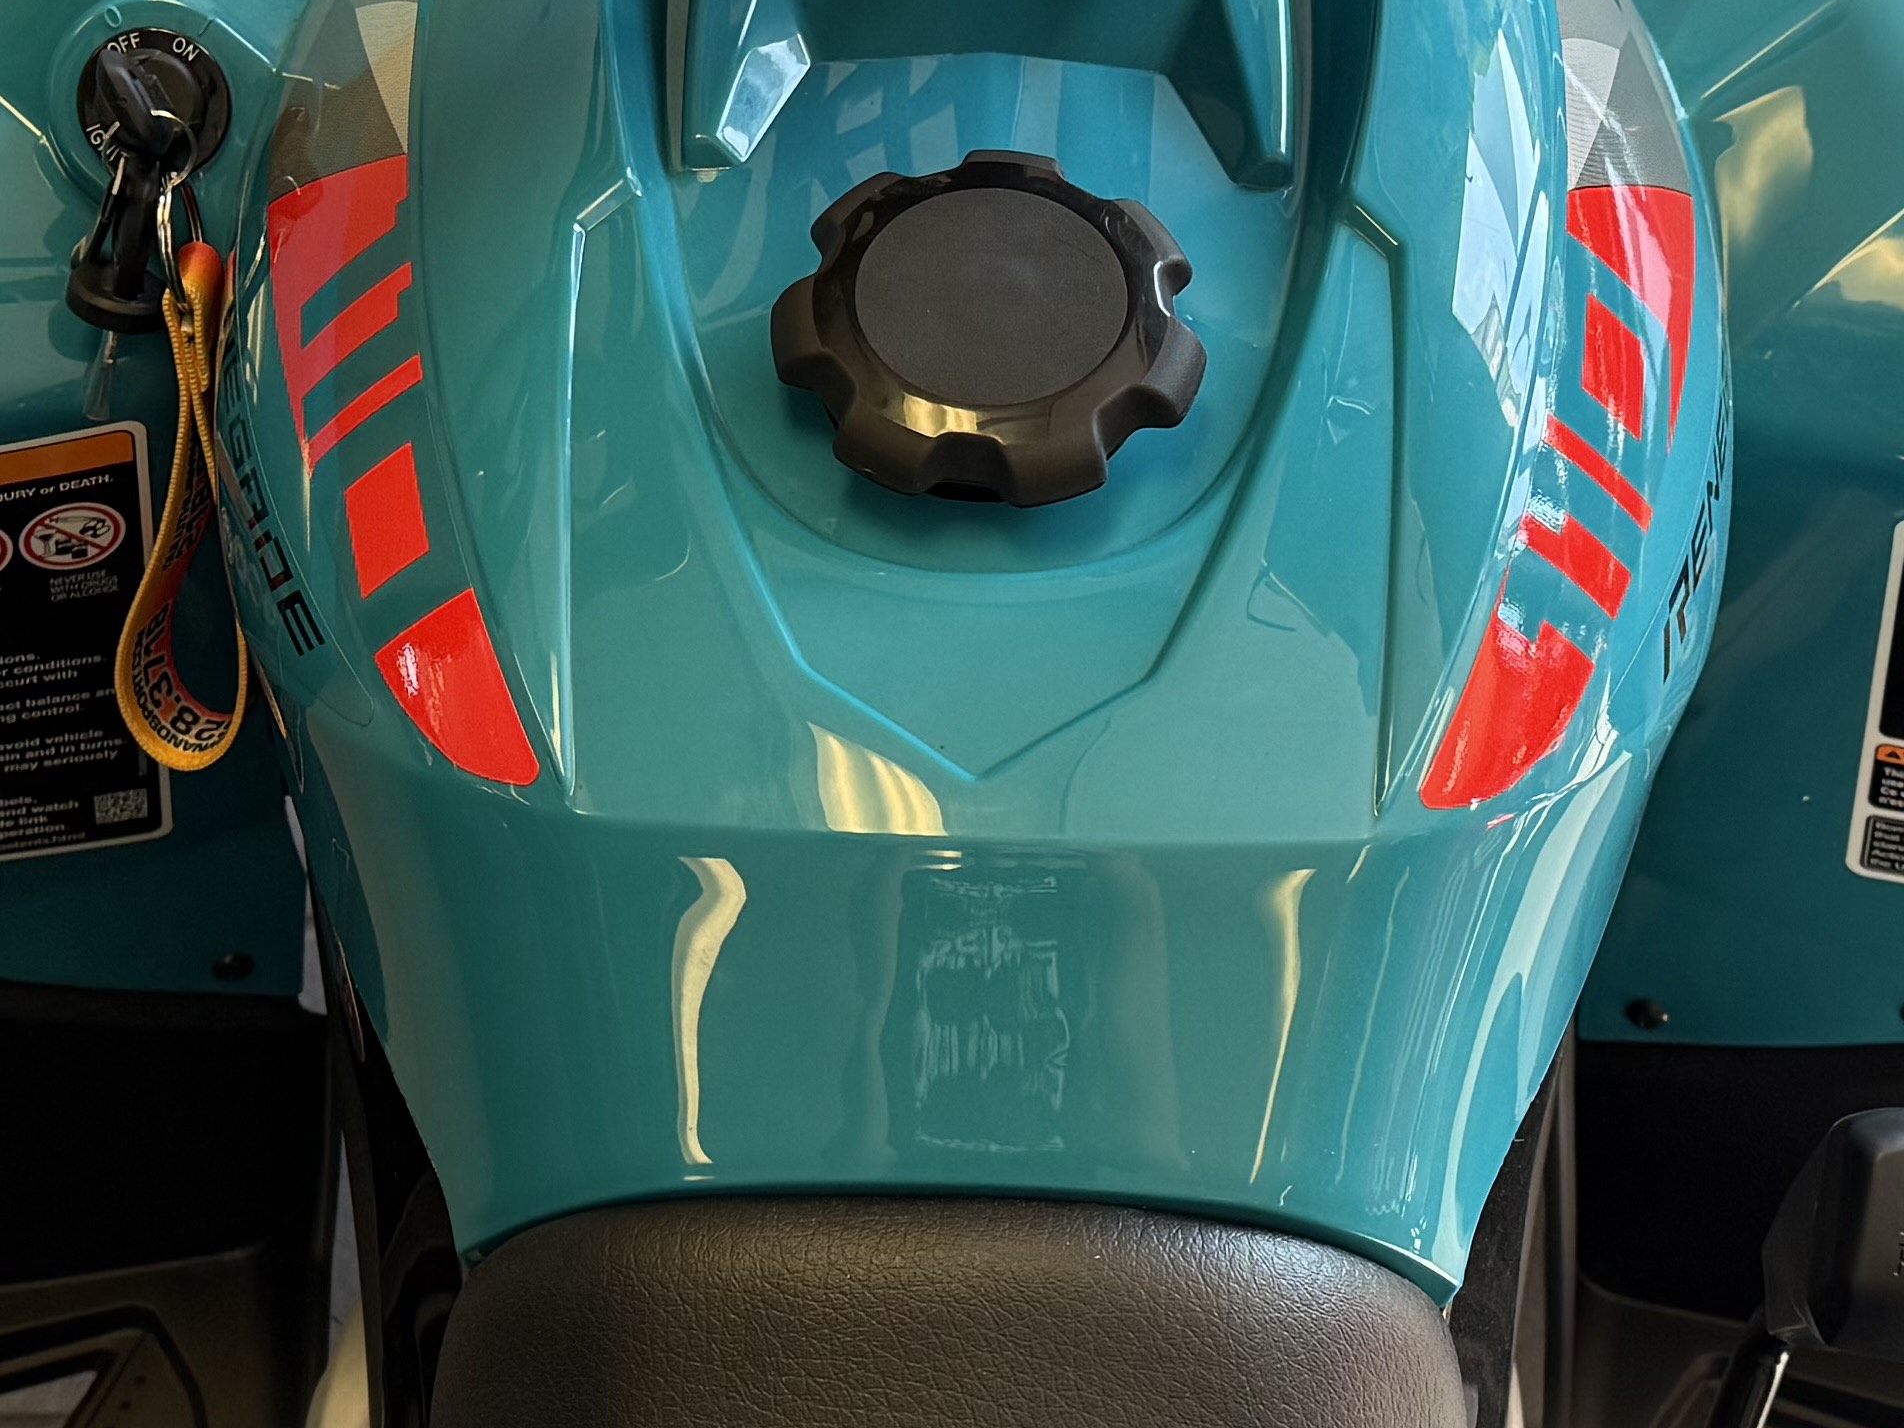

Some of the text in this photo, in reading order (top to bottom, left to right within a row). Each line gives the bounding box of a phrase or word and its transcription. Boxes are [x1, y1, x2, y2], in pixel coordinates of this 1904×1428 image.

[107, 32, 199, 61] OFF ON
[38, 485, 56, 495] or
[58, 473, 114, 492] DEATH.
[12, 654, 102, 676] conditions.
[41, 668, 79, 683] with
